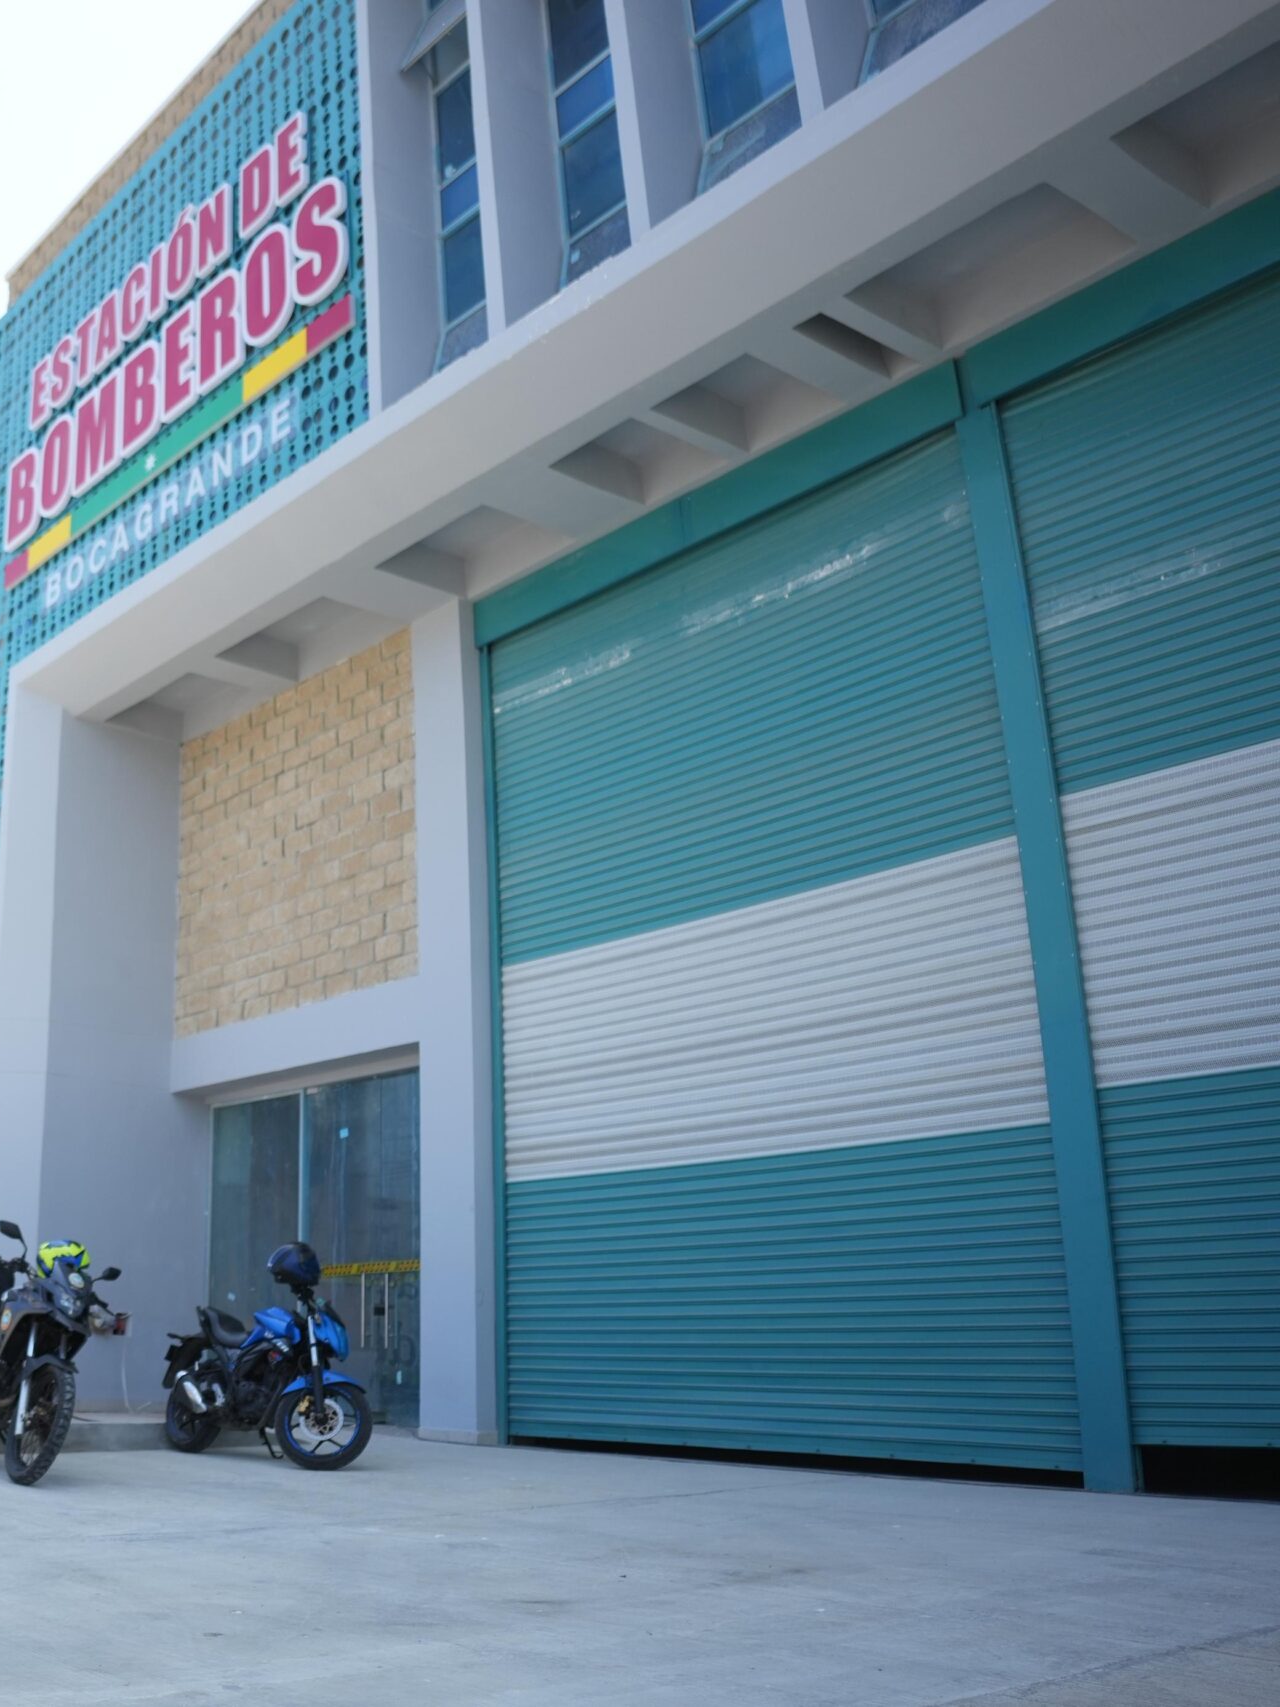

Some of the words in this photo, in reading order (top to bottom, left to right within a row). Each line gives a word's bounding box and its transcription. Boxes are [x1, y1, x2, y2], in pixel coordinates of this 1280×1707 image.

[5, 175, 348, 552] BOMBEROS
[30, 183, 232, 431] ESTACIÓN
[239, 111, 309, 238] DE
[46, 399, 293, 608] BOCAGRANDE
